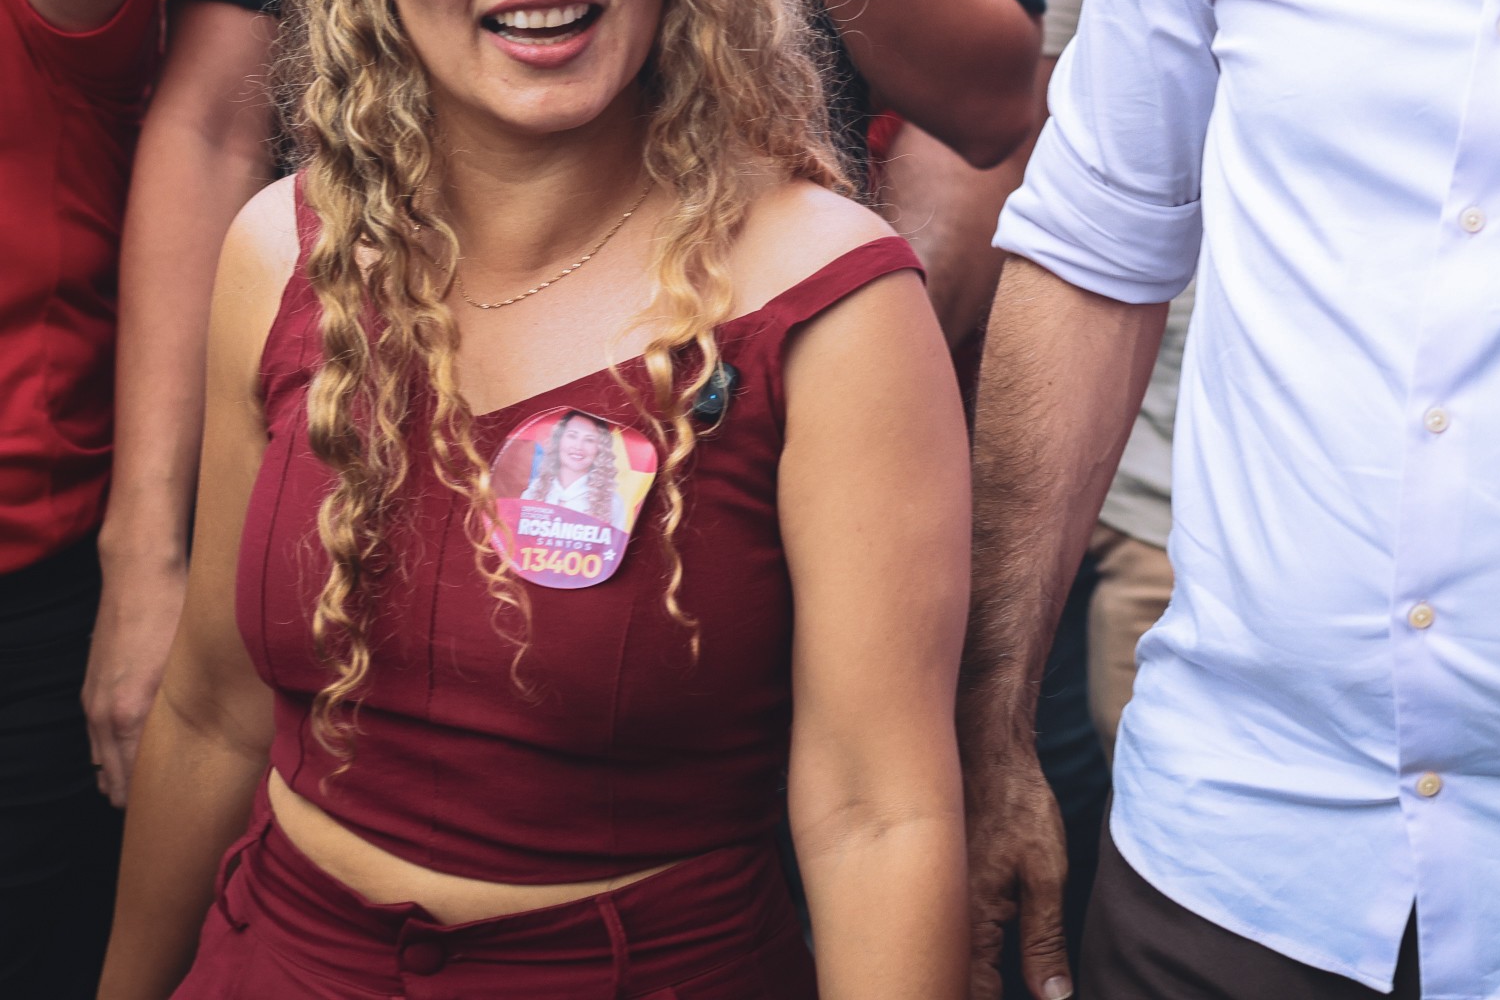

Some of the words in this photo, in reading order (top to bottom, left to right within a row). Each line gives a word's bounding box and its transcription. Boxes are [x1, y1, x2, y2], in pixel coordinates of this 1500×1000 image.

[518, 517, 612, 545] ROSÂNGELA
[536, 538, 592, 550] SANTOS
[520, 548, 602, 578] 13400
